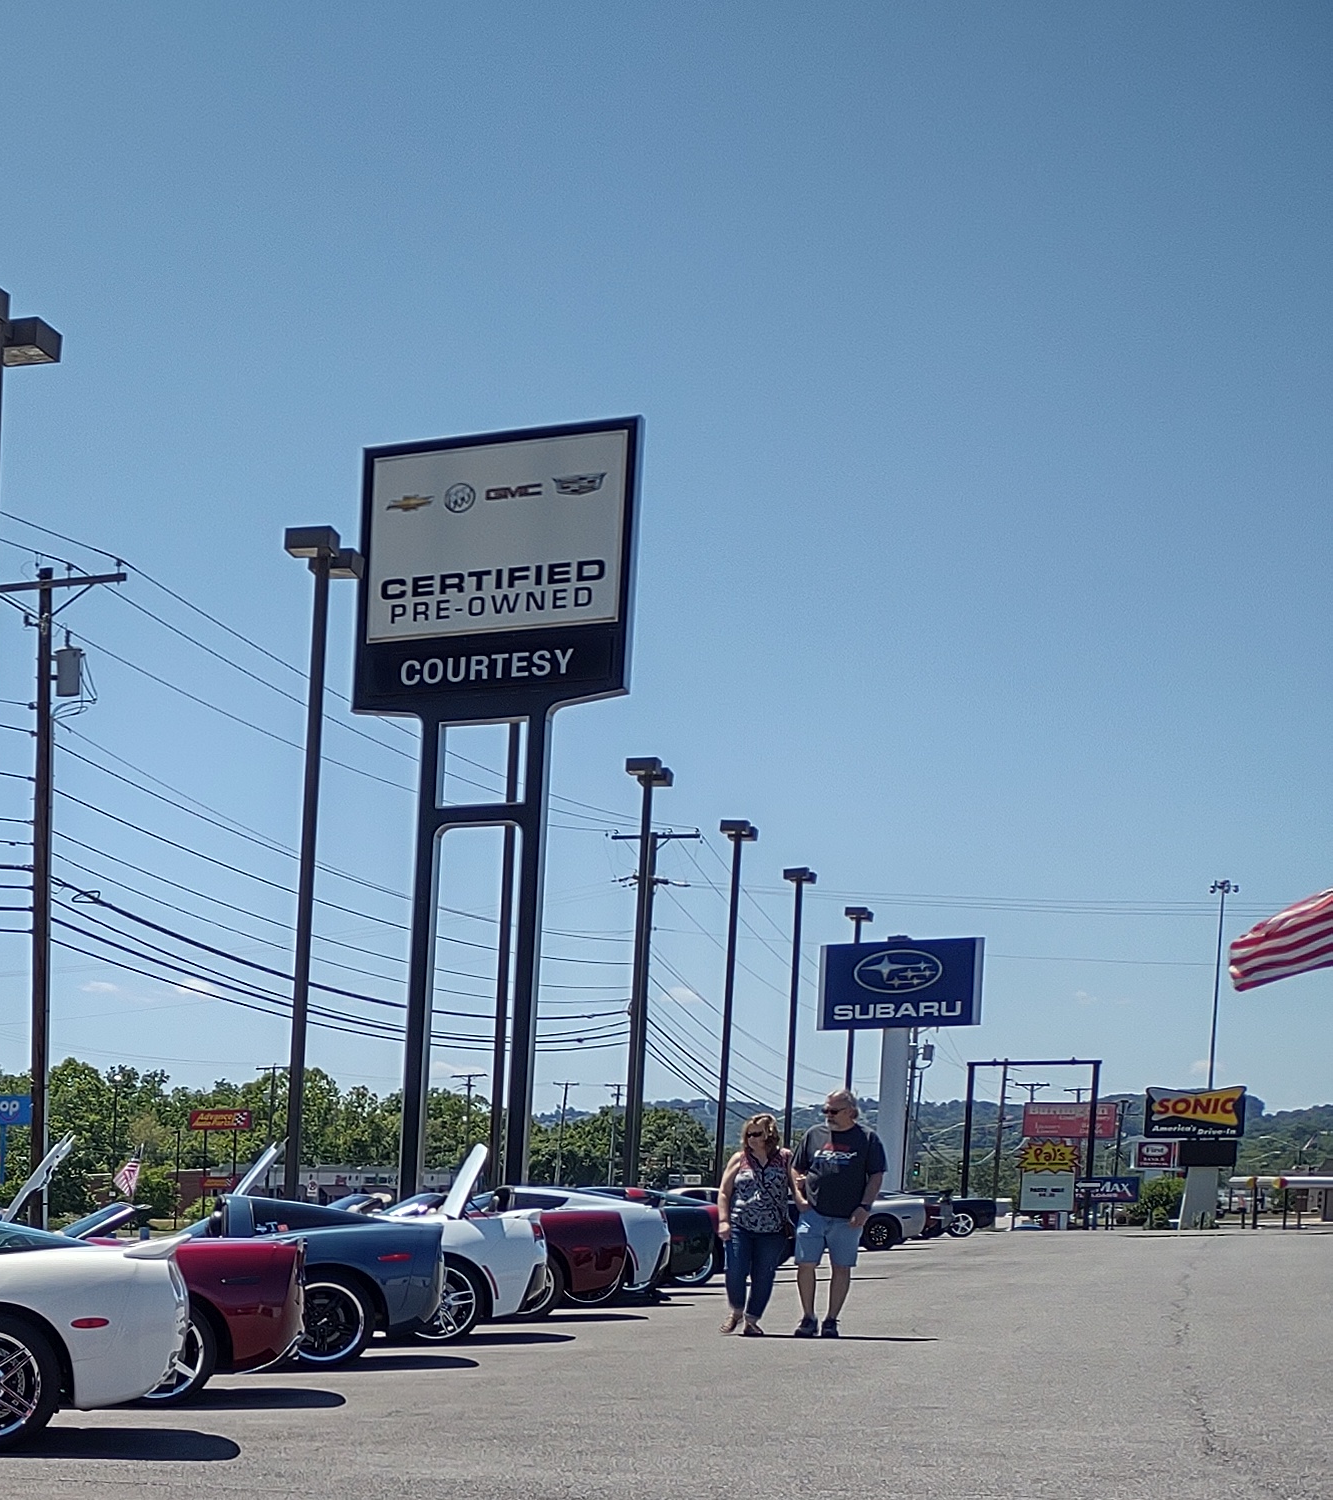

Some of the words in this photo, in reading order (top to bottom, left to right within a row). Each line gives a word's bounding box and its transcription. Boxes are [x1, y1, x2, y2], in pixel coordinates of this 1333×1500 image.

[485, 483, 543, 500] GMC
[381, 559, 605, 600] CERTIFIED
[390, 586, 592, 624] PRE-OWNED
[400, 648, 574, 686] COURTESY
[833, 1001, 962, 1021] SUBARU
[1155, 1097, 1238, 1115] SONIC
[1152, 1124, 1197, 1132] America's
[1034, 1147, 1066, 1161] Pal's
